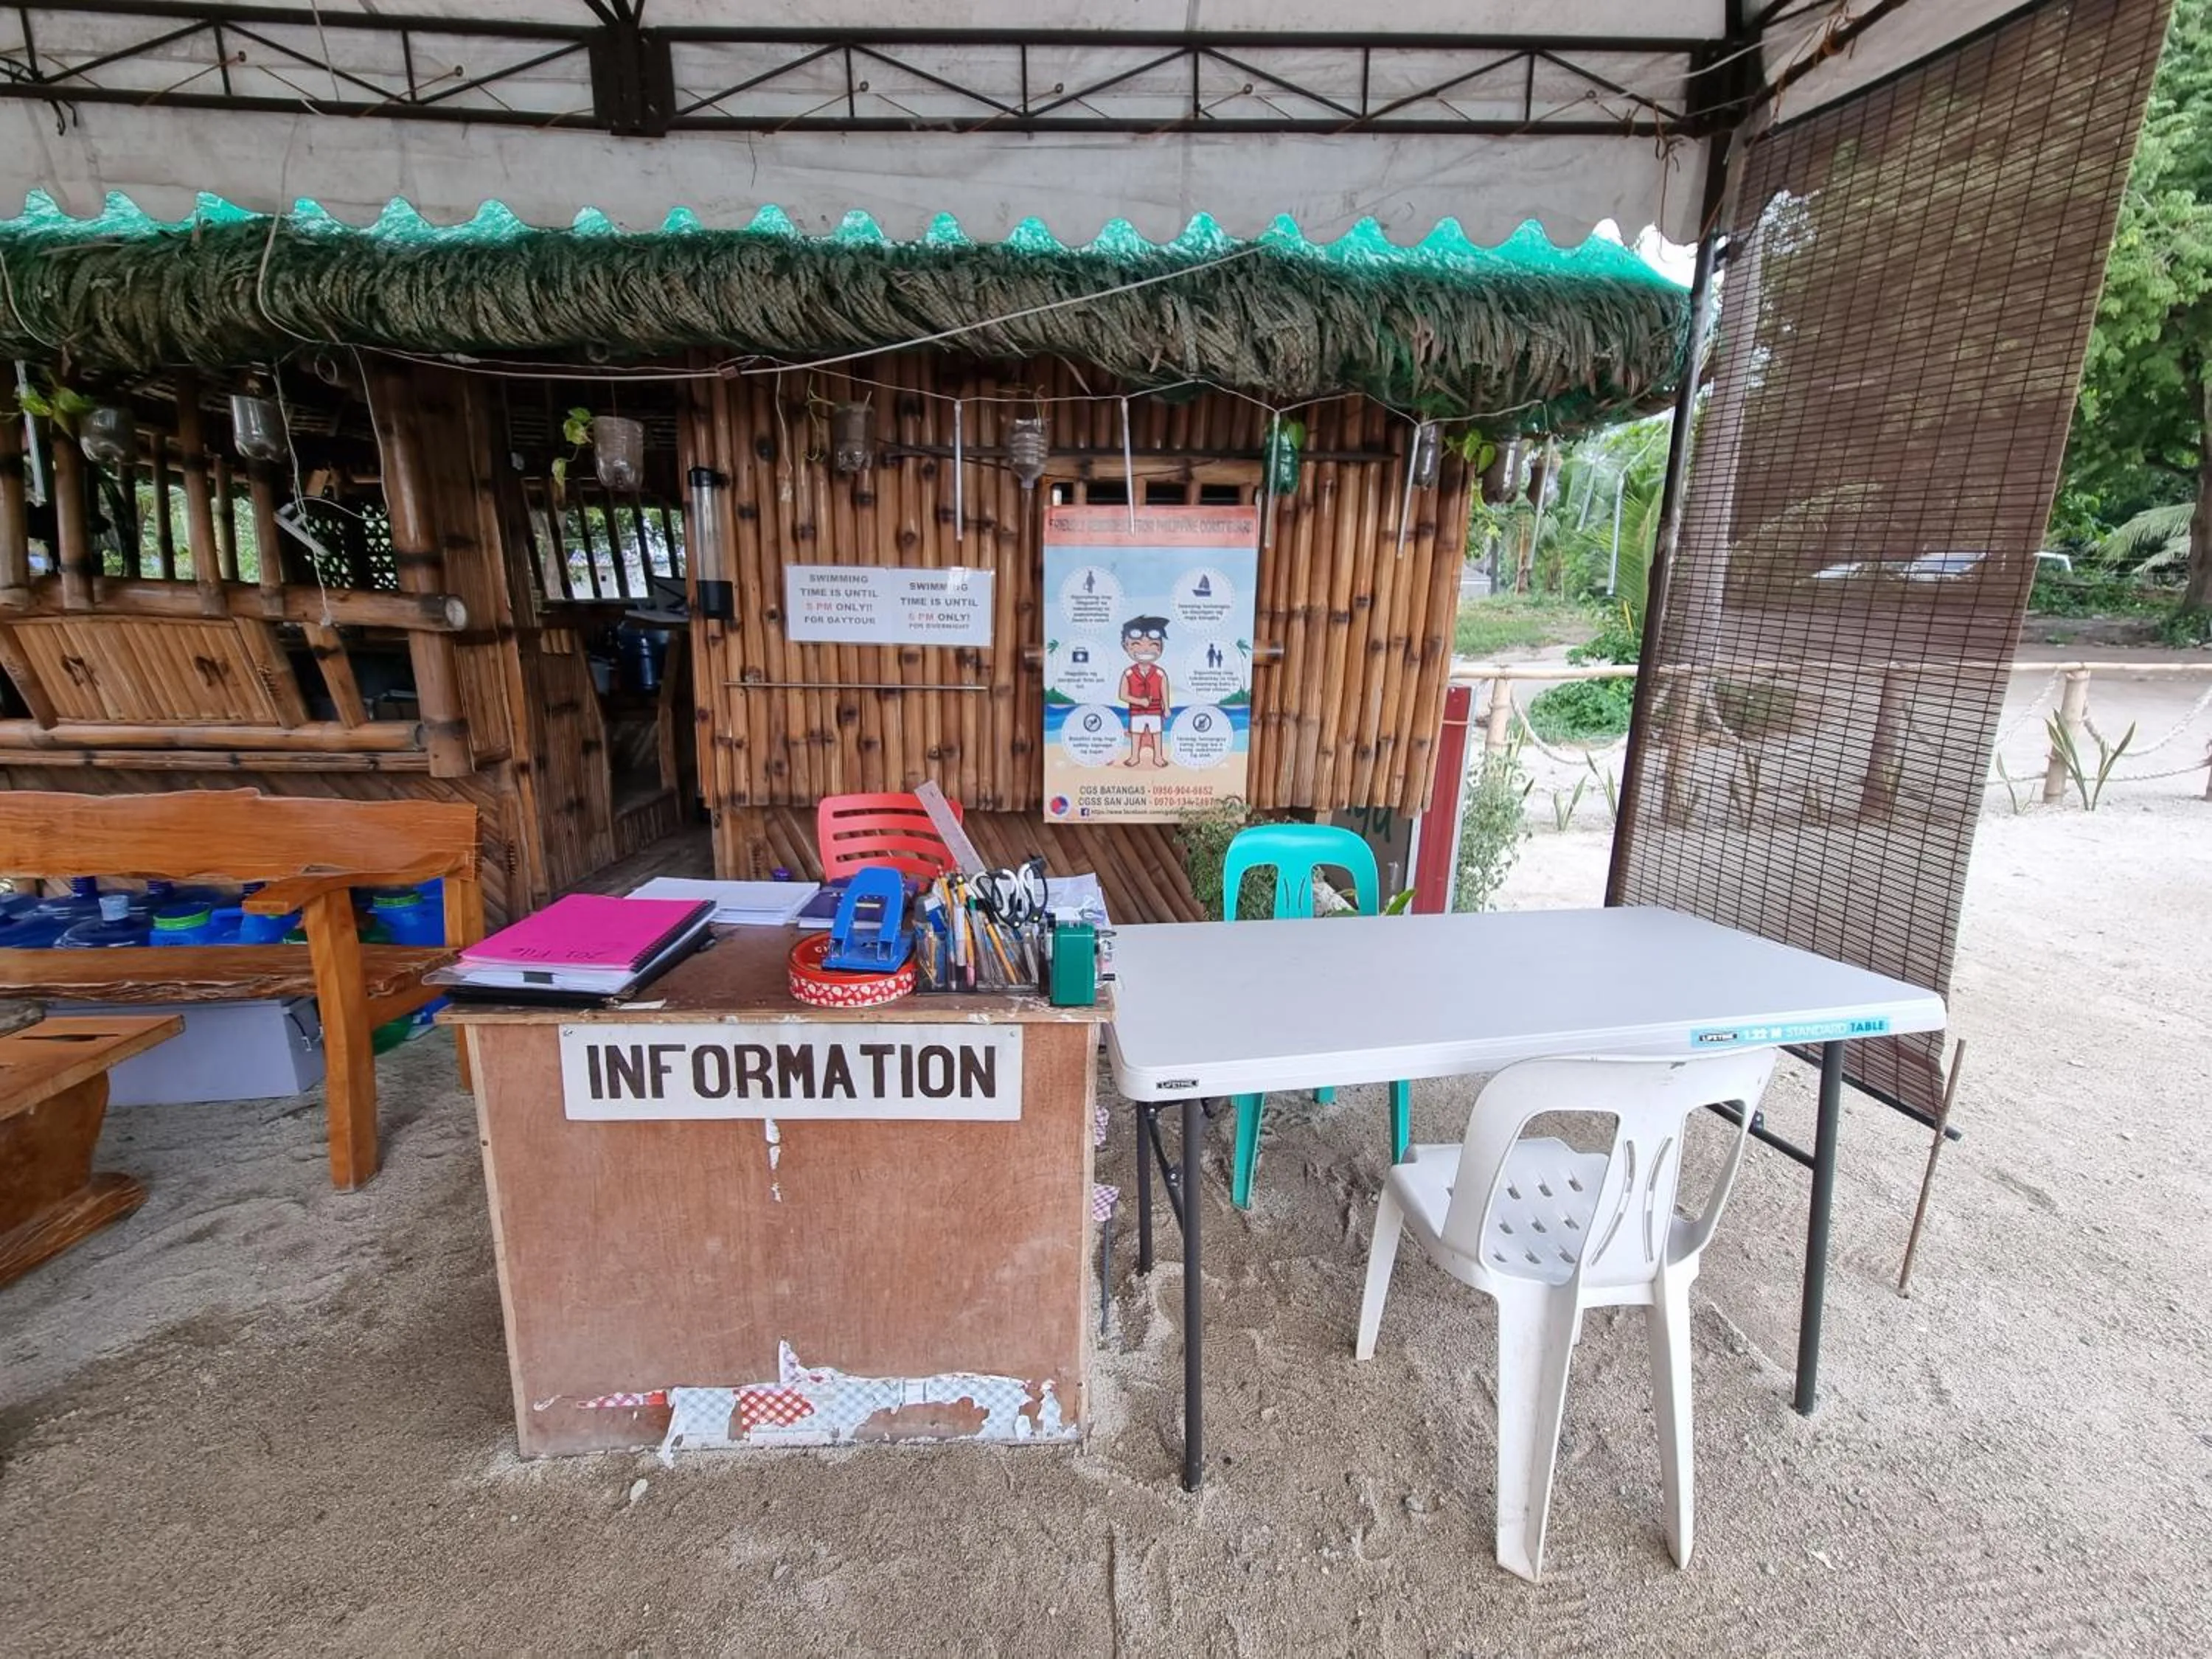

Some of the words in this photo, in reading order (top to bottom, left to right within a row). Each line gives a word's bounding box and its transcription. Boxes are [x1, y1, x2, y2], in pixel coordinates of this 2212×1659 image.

[809, 574, 869, 583] SWIMMING
[800, 588, 827, 597] TIME
[831, 588, 841, 597] IS
[844, 589, 879, 598] UNTIL
[816, 602, 833, 611] PM
[900, 597, 927, 606] TIME
[931, 598, 941, 606] IS
[945, 598, 978, 607] UNTIL
[804, 616, 824, 624] FOR
[827, 616, 876, 625] DAYTOUR
[918, 613, 934, 622] PM
[1079, 785, 1098, 795] CGS
[1099, 785, 1146, 796] BATANGAS
[1078, 796, 1102, 806] CGSS
[1104, 796, 1121, 806] SAN
[1124, 796, 1147, 806] JUAN
[1787, 1023, 1846, 1037] STANDARD
[1850, 1020, 1885, 1032] TABLE
[585, 1043, 997, 1099] INFORMATION
